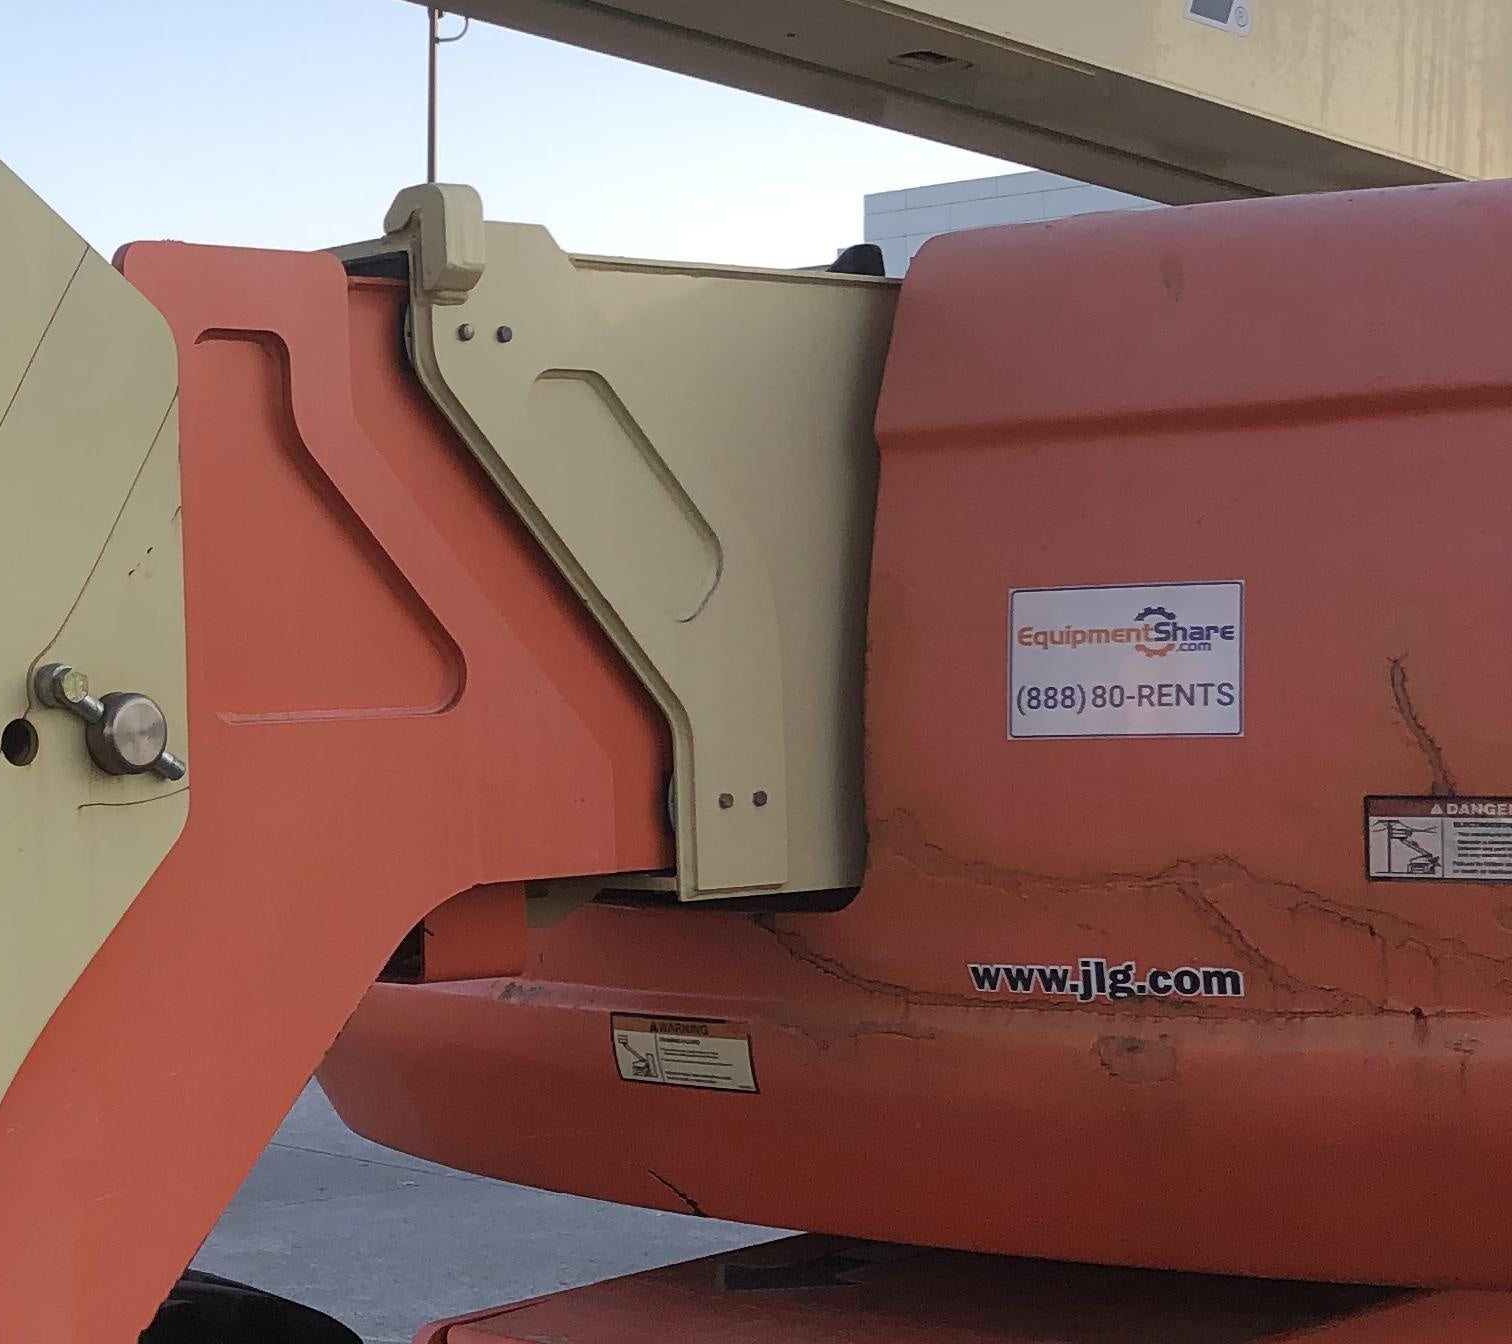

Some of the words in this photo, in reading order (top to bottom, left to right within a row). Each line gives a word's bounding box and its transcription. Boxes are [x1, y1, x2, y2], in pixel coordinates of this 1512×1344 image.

[1017, 621, 1235, 650] EquipmentShare
[1176, 641, 1212, 652] .com
[1016, 683, 1086, 716] (888)
[1091, 682, 1235, 708] 80-RENTS
[968, 958, 1245, 1002] www.jlg.com
